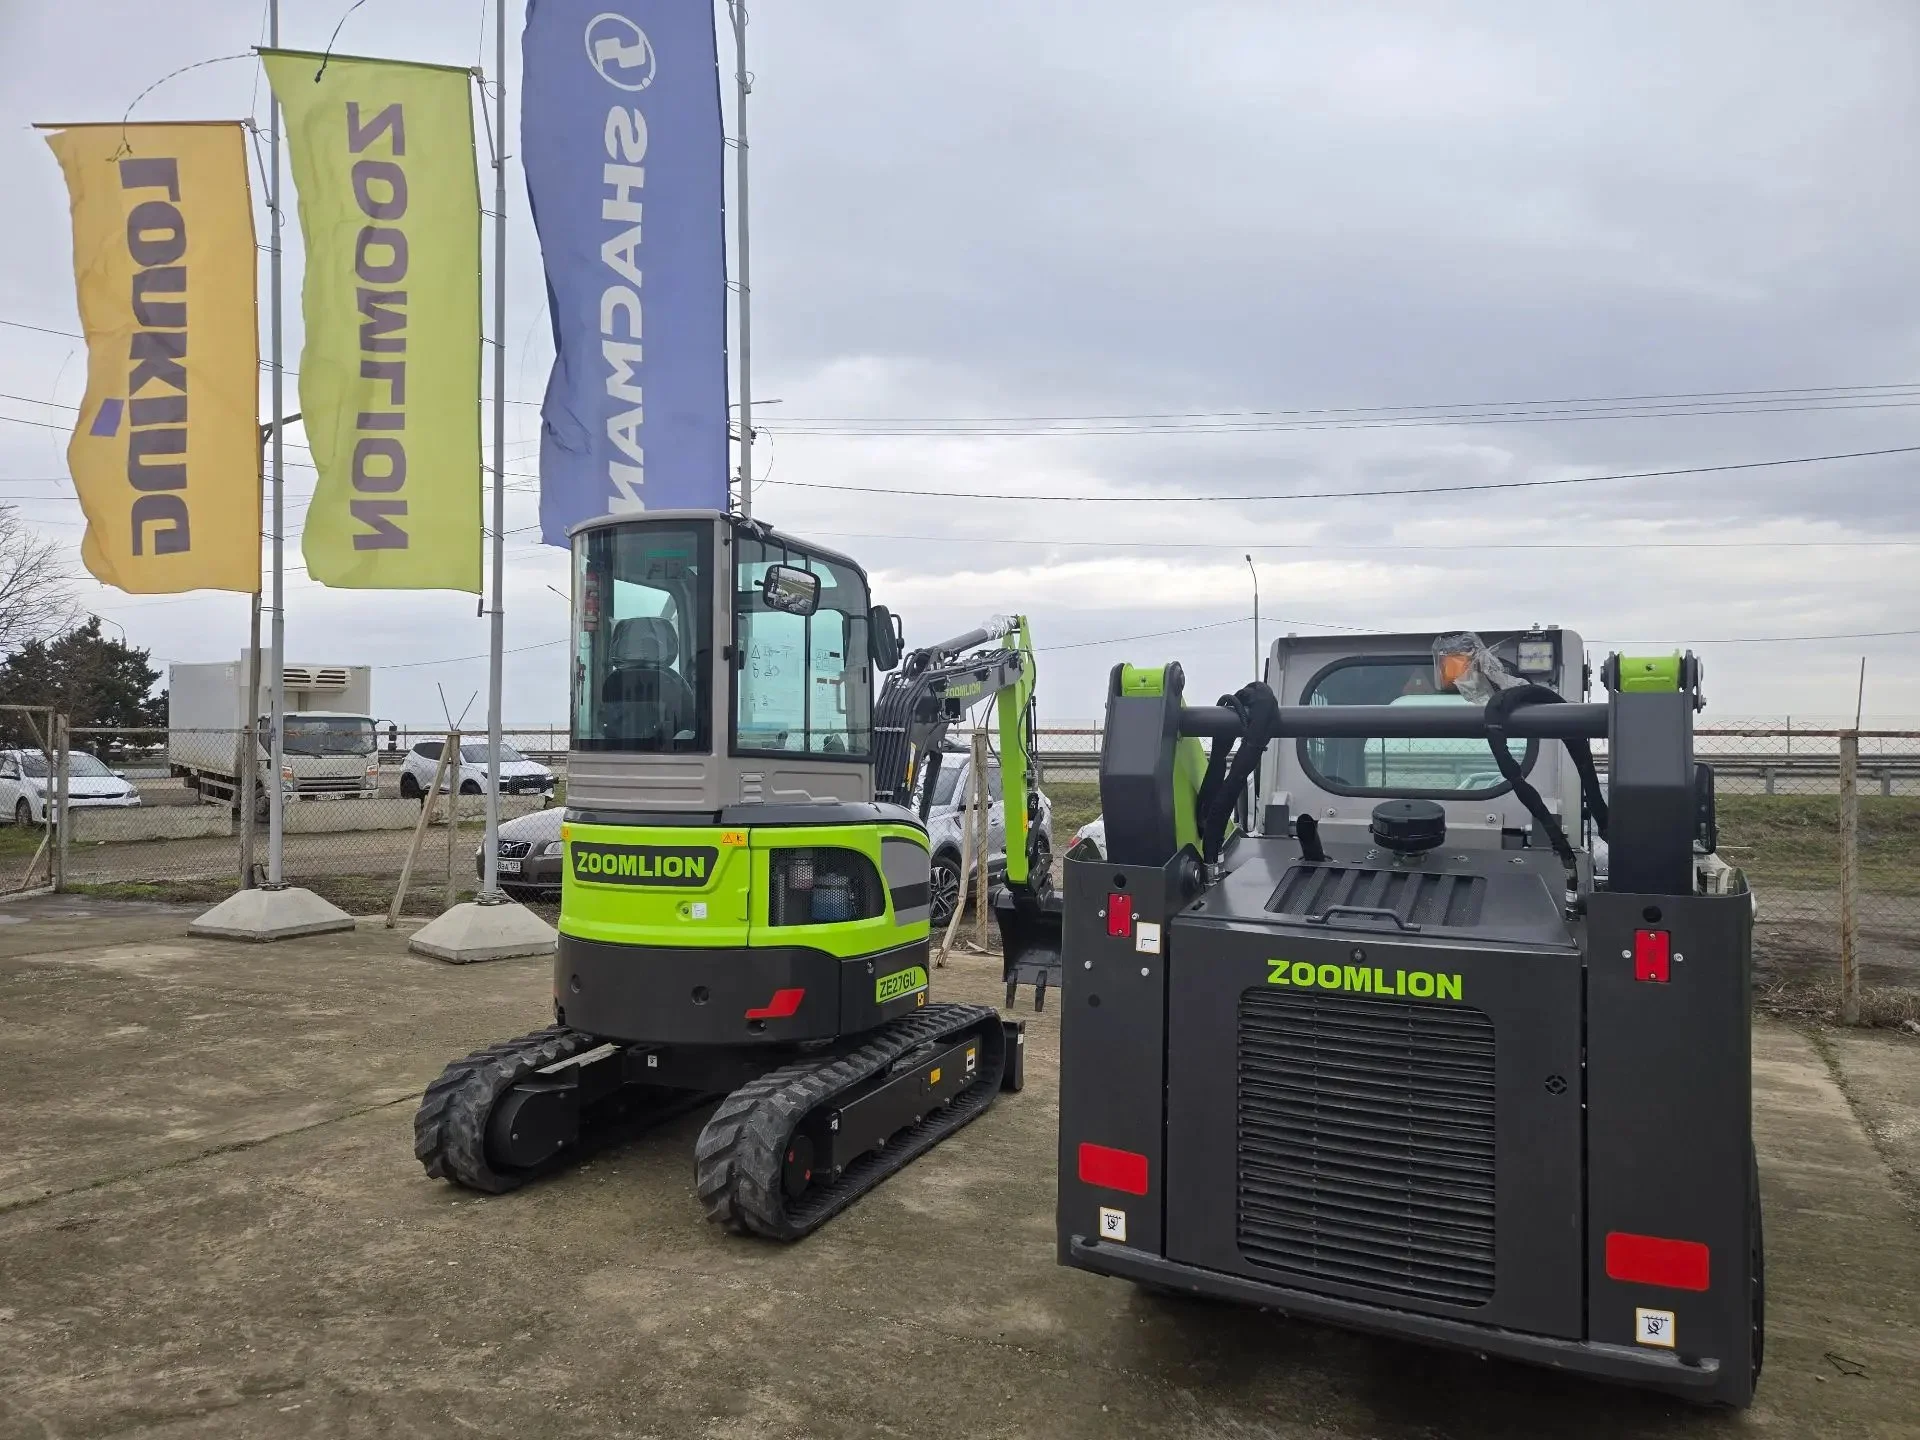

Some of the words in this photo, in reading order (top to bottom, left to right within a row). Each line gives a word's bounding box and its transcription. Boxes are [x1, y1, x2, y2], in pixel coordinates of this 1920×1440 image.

[576, 851, 705, 878] ZOOMLION
[879, 969, 916, 999] ZE27GU
[1266, 958, 1463, 1001] ZOOMLION
